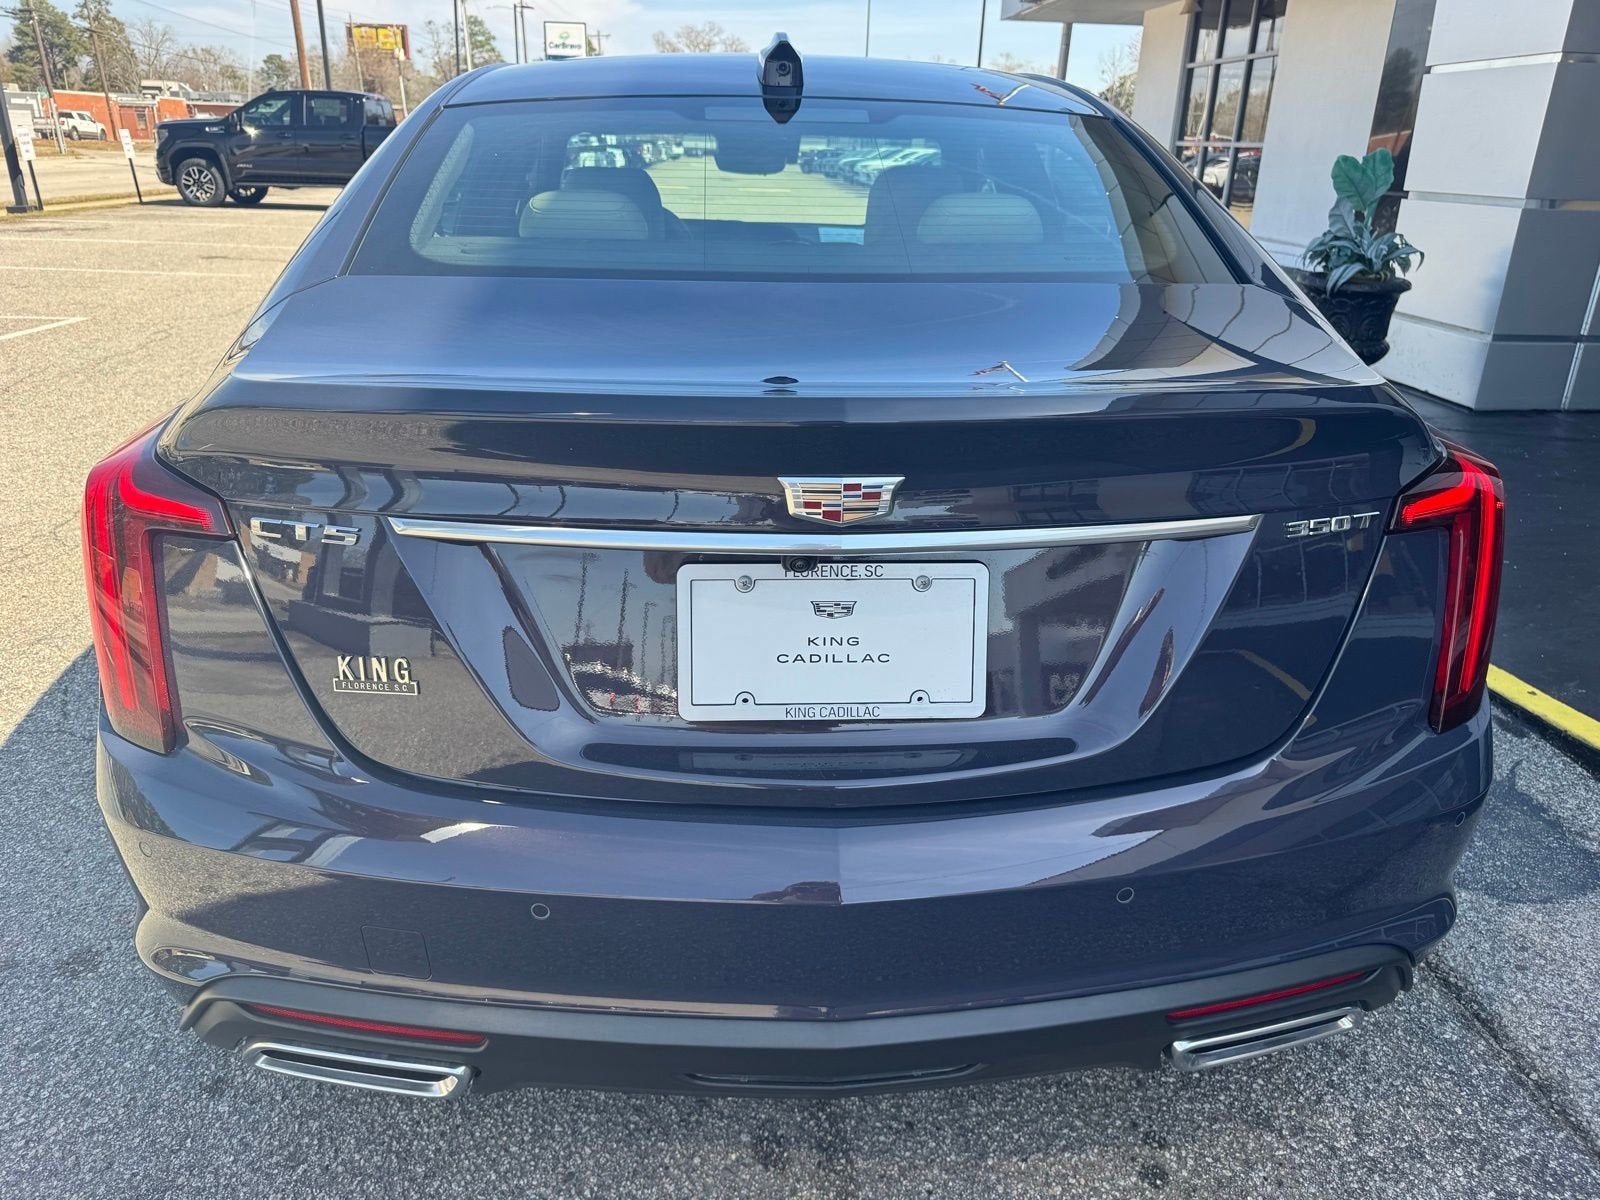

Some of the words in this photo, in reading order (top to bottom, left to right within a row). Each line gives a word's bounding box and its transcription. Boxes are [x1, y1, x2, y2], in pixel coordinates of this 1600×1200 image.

[1285, 511, 1380, 538] 350T
[250, 517, 360, 546] CT5
[864, 565, 884, 578] SC
[807, 636, 860, 647] KING
[776, 653, 890, 664] CADILLAC
[337, 655, 410, 683] KING
[785, 707, 816, 718] KING
[819, 706, 881, 718] CADILLAC
